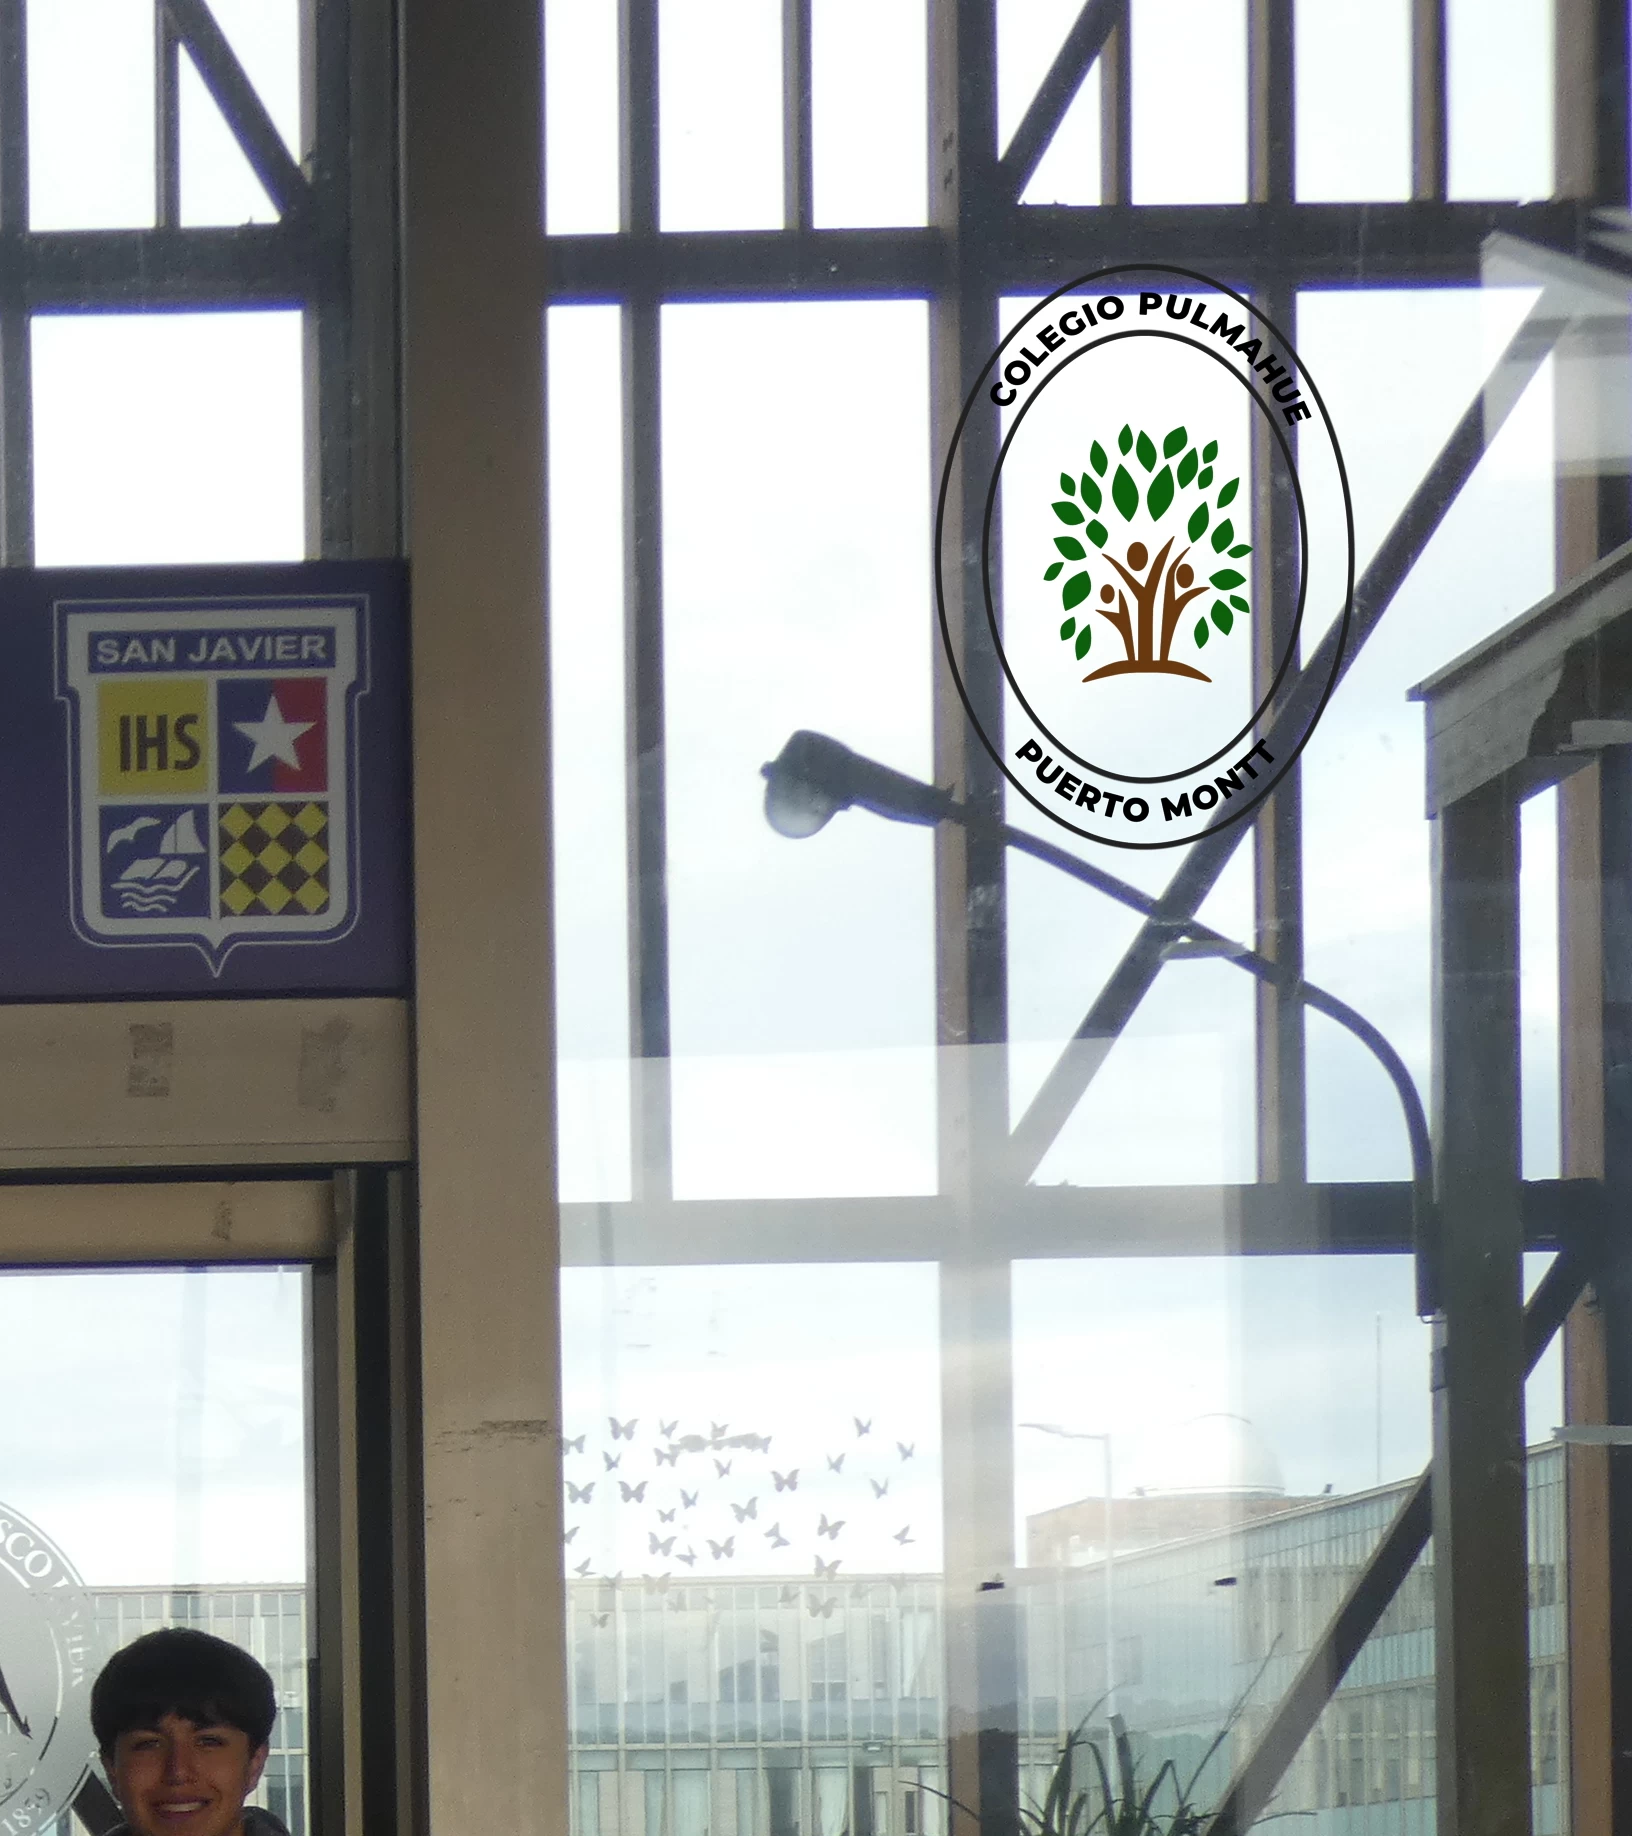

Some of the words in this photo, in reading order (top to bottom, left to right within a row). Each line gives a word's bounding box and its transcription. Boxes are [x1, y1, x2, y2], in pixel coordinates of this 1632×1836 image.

[96, 637, 176, 665] SAN
[187, 634, 328, 663] JAVIER
[118, 713, 202, 774] IHS
